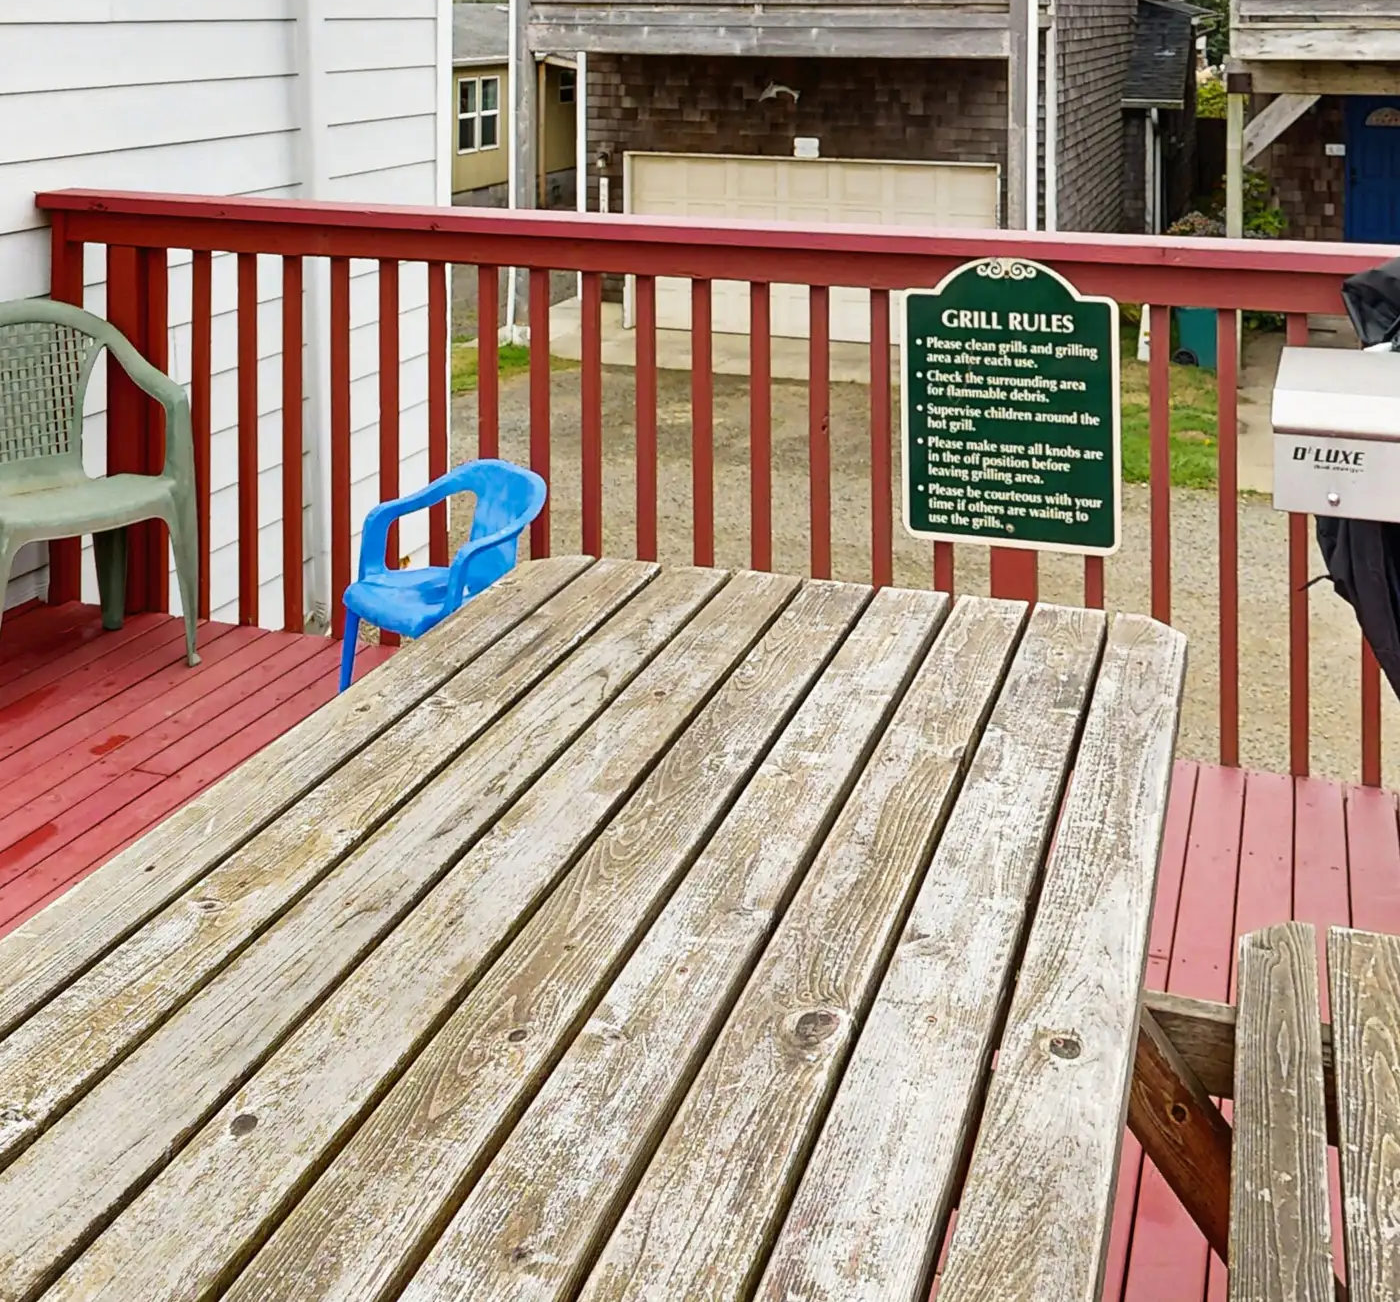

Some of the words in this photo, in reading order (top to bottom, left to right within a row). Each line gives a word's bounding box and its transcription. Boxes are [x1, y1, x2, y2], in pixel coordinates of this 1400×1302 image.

[942, 309, 1003, 329] GRILL
[1009, 312, 1074, 333] RULES
[926, 337, 962, 349] Please
[965, 339, 996, 351] clean
[999, 341, 1027, 355] grills
[1030, 343, 1052, 355] and
[1055, 345, 1099, 360] grilling
[927, 354, 952, 363] area
[954, 352, 981, 365] after
[984, 355, 1012, 367] each
[1015, 358, 1038, 368] use.
[927, 370, 962, 383] Check
[965, 372, 983, 384] the
[986, 375, 1057, 391] surrounding
[1060, 381, 1086, 391] area
[927, 384, 944, 396] for
[947, 385, 1007, 400] flammable
[1010, 389, 1049, 403] debris.
[927, 403, 981, 419] Supervise
[984, 407, 1032, 421] children
[1035, 410, 1078, 424] around
[1081, 413, 1100, 425] the
[928, 418, 947, 430] hot
[950, 419, 976, 433] grill.
[928, 436, 963, 449] Please
[967, 439, 997, 452] make
[1000, 444, 1025, 455] sure
[1028, 443, 1043, 456] all
[1046, 444, 1081, 458] knobs
[1084, 450, 1103, 460] are
[928, 451, 940, 462] in
[943, 452, 961, 463] the
[964, 453, 980, 465] off
[983, 455, 1029, 470] position
[1032, 458, 1070, 472] before
[928, 464, 968, 481] leaving
[971, 467, 1012, 484] grilling
[1015, 474, 1044, 484] area.
[929, 484, 964, 497] Please
[967, 486, 981, 498] be
[984, 490, 1042, 503] courteous
[1045, 493, 1072, 506] with
[1075, 497, 1102, 509] your
[929, 499, 954, 511] time
[958, 500, 966, 512] if
[968, 502, 1004, 515] others
[1007, 506, 1026, 516] are
[1030, 506, 1073, 523] waiting
[1076, 511, 1088, 521] to
[929, 514, 947, 523] use
[951, 513, 969, 525] the
[972, 516, 1004, 530] grills.
